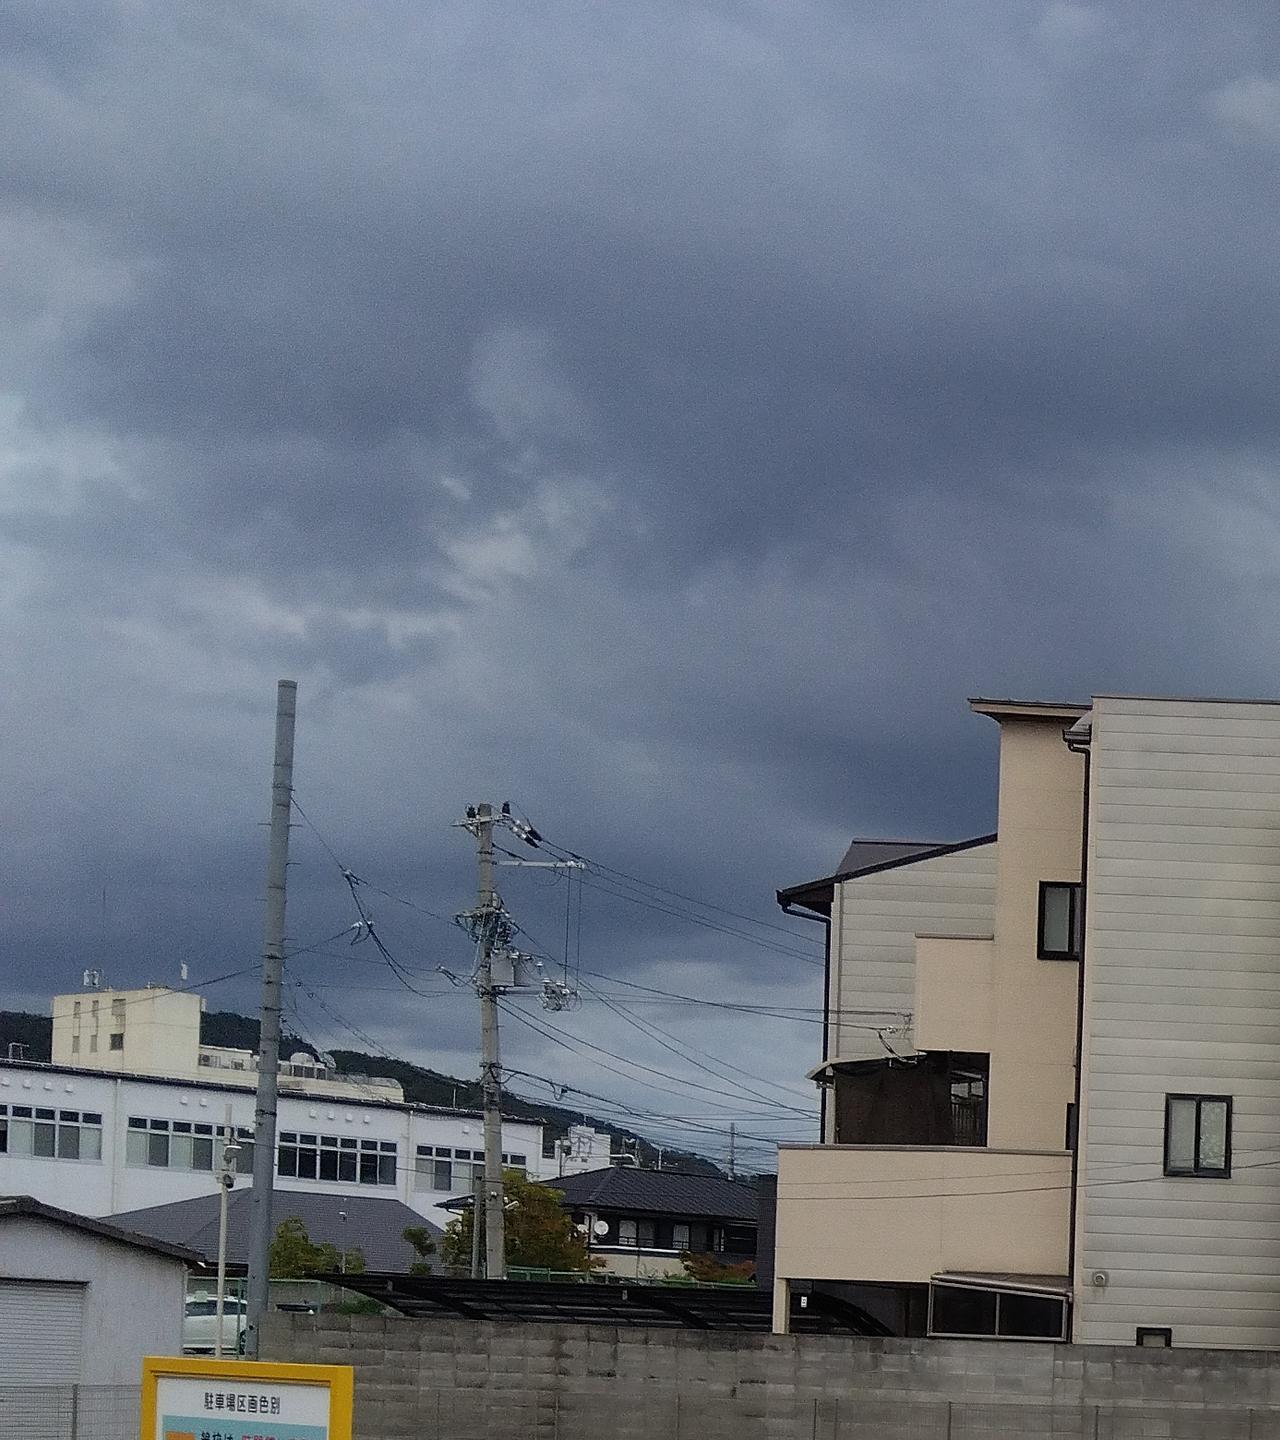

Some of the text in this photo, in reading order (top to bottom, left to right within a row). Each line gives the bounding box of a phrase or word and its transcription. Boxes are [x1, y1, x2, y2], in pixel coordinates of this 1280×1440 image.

[204, 1392, 281, 1415] 駐車場区画色別
